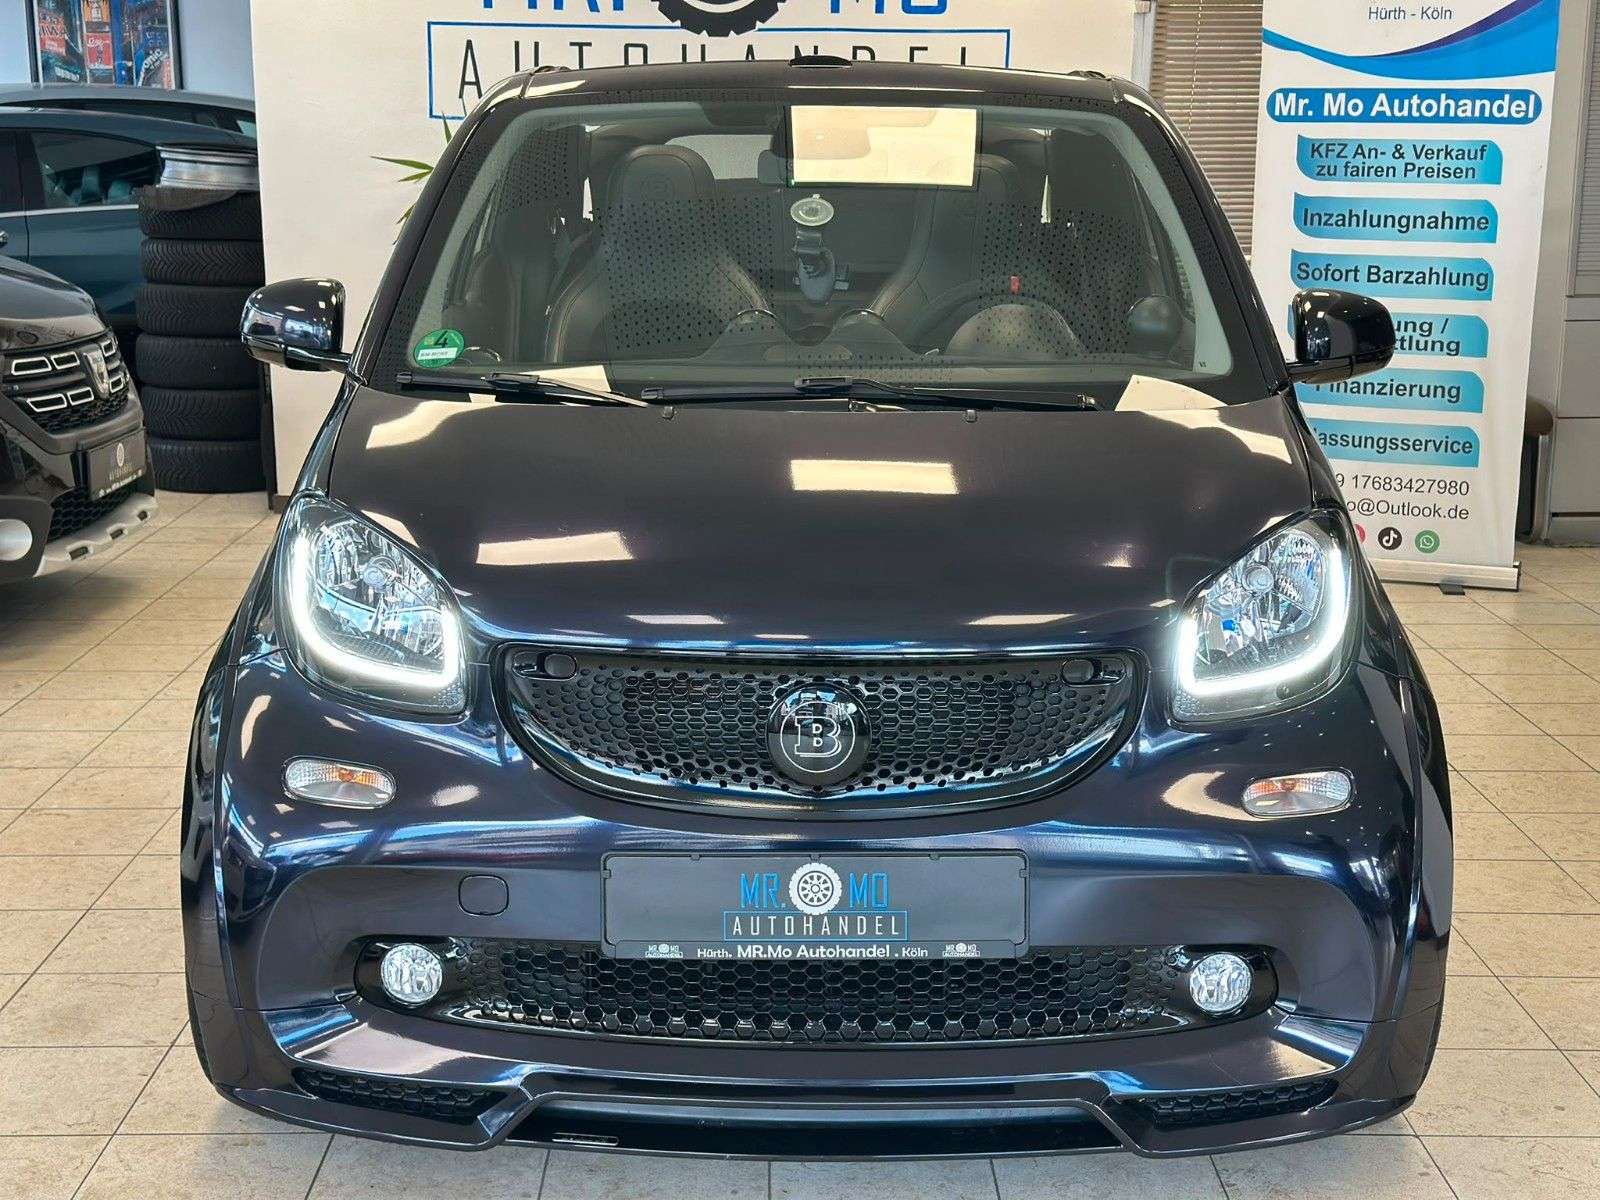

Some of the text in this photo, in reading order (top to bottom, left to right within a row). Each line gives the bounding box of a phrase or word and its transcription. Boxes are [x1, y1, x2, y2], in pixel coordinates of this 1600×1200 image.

[1368, 7, 1406, 20] Hürth
[1421, 7, 1452, 20] Köln
[1274, 93, 1534, 118] Mr. Mo Autohandel
[1311, 143, 1487, 161] KFZ An- & Verkauf
[1316, 161, 1476, 179] zu fairen Preisen
[1303, 208, 1490, 233] Inzahlungnahme
[1297, 262, 1489, 291] Sofort Barzahlung
[434, 330, 448, 348] 4
[1314, 427, 1473, 454] assungsservice
[1352, 474, 1470, 496] 17683427980
[1348, 498, 1469, 520] o@Outlook.de
[849, 872, 890, 908] MO
[732, 915, 900, 936] AUTOHANDEL
[796, 945, 890, 958] Autohandel
[902, 947, 929, 958] Köln
